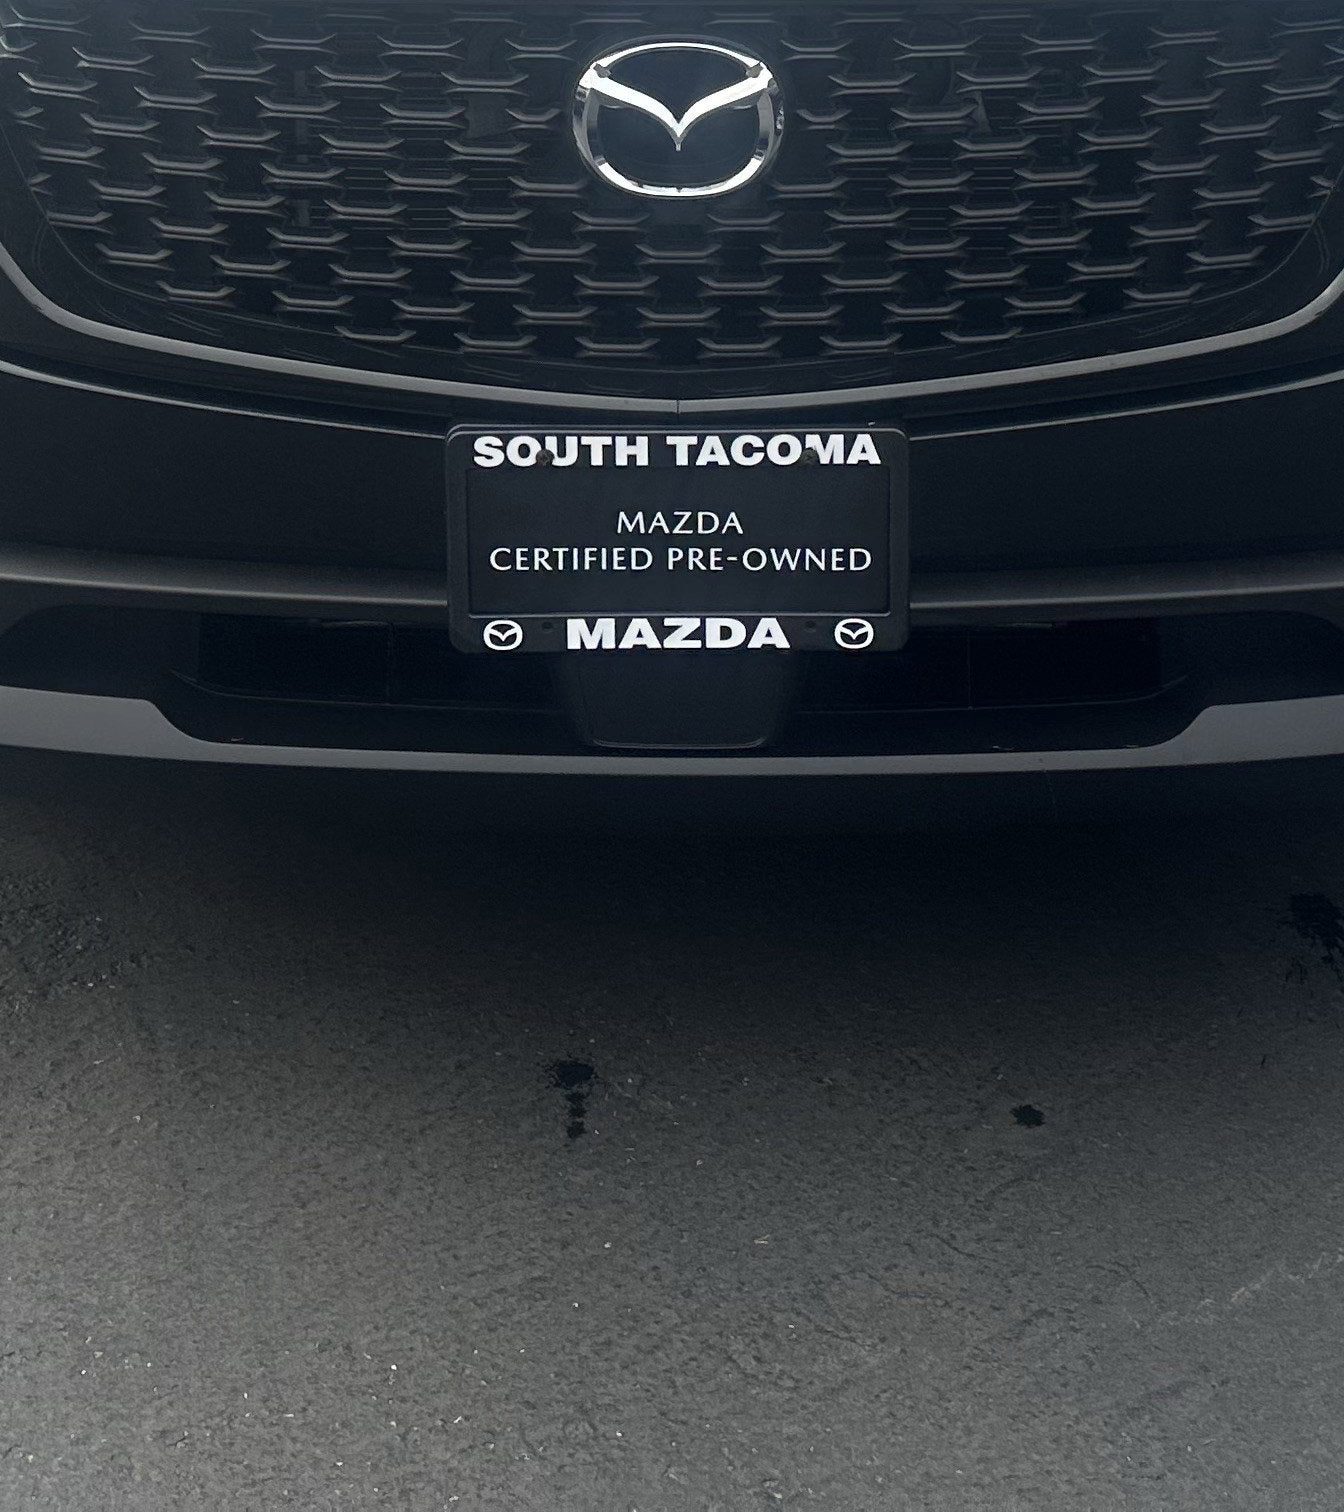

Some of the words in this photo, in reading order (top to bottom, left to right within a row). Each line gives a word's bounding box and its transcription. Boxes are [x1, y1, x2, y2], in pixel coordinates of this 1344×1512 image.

[473, 434, 649, 468] SOUTH
[666, 433, 881, 467] TACOMA
[616, 511, 744, 535] MAZDA
[489, 546, 654, 572] CERTIFIED
[668, 546, 873, 572] PRE-OWNED
[566, 617, 790, 650] MAZDA
